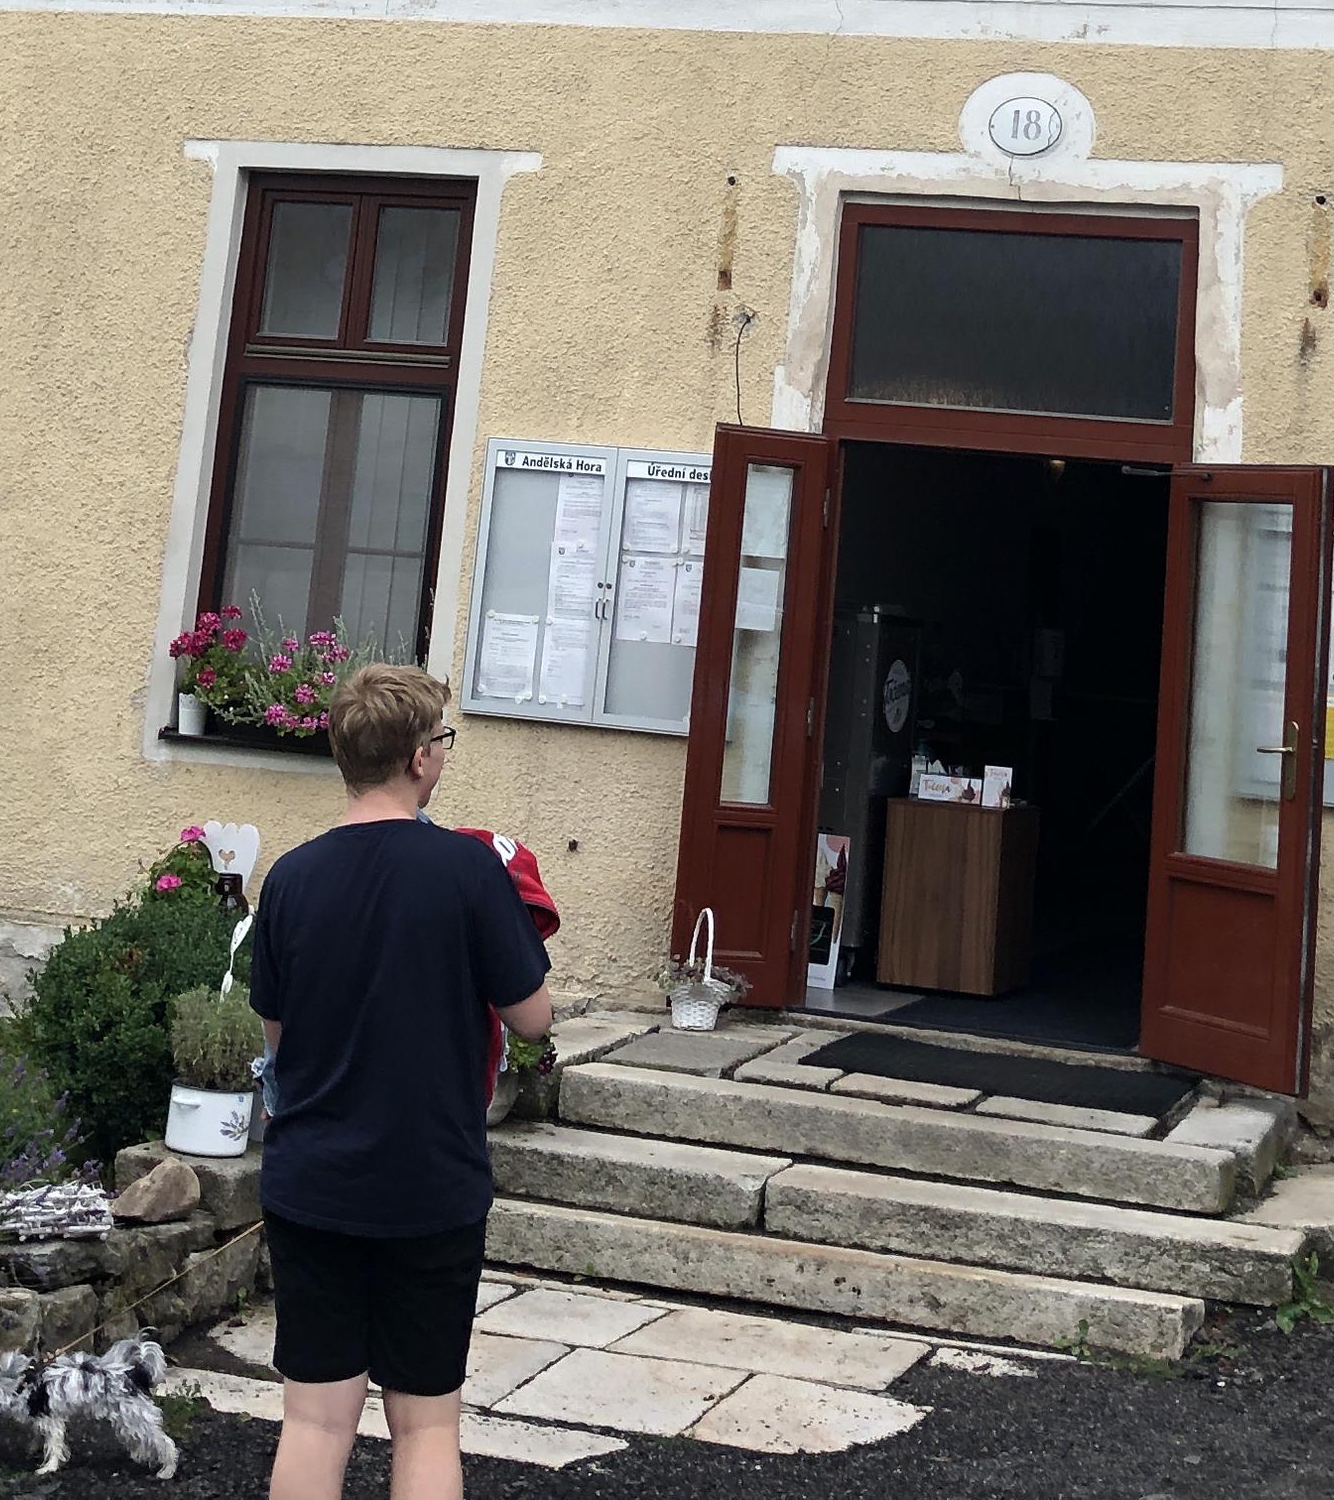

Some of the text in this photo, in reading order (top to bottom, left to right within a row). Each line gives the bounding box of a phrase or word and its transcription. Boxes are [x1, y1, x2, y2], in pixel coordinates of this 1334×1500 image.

[1010, 109, 1042, 140] 18
[521, 455, 603, 473] Andělská Hora
[647, 462, 712, 481] Úřední des
